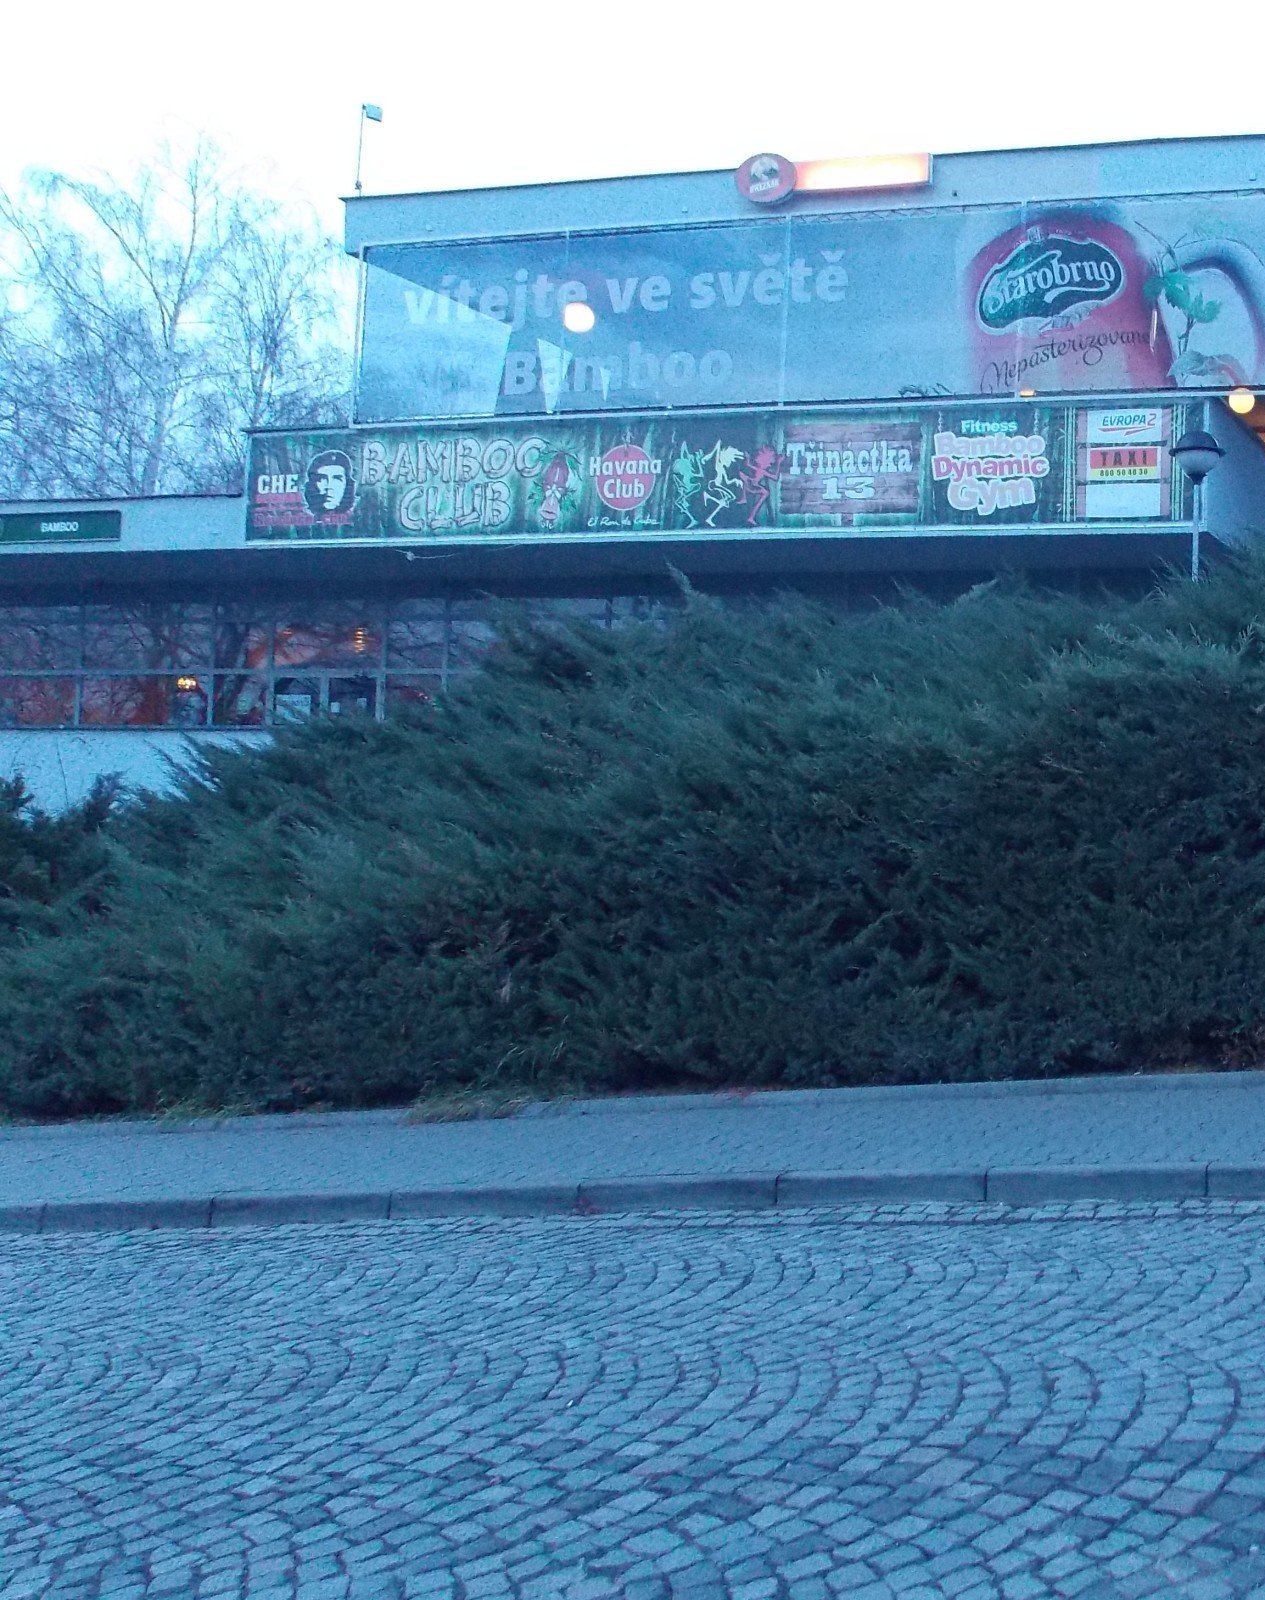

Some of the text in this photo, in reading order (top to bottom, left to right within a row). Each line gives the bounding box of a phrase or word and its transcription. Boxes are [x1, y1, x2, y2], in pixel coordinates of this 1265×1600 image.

[403, 250, 849, 332] vítejte ve světě
[982, 250, 1116, 314] Starobrno
[503, 341, 734, 397] Bamboo
[961, 420, 1018, 433] Fitness
[934, 432, 1046, 457] Bamboo
[589, 456, 662, 476] Havana
[933, 453, 1048, 482] Dynamic
[1101, 450, 1148, 467] TAXI
[257, 473, 300, 495] CHE
[603, 478, 645, 498] Club
[822, 476, 876, 500] 13
[400, 480, 512, 531] CLUB
[948, 478, 1036, 515] Gym
[41, 521, 79, 533] BAMBOO
